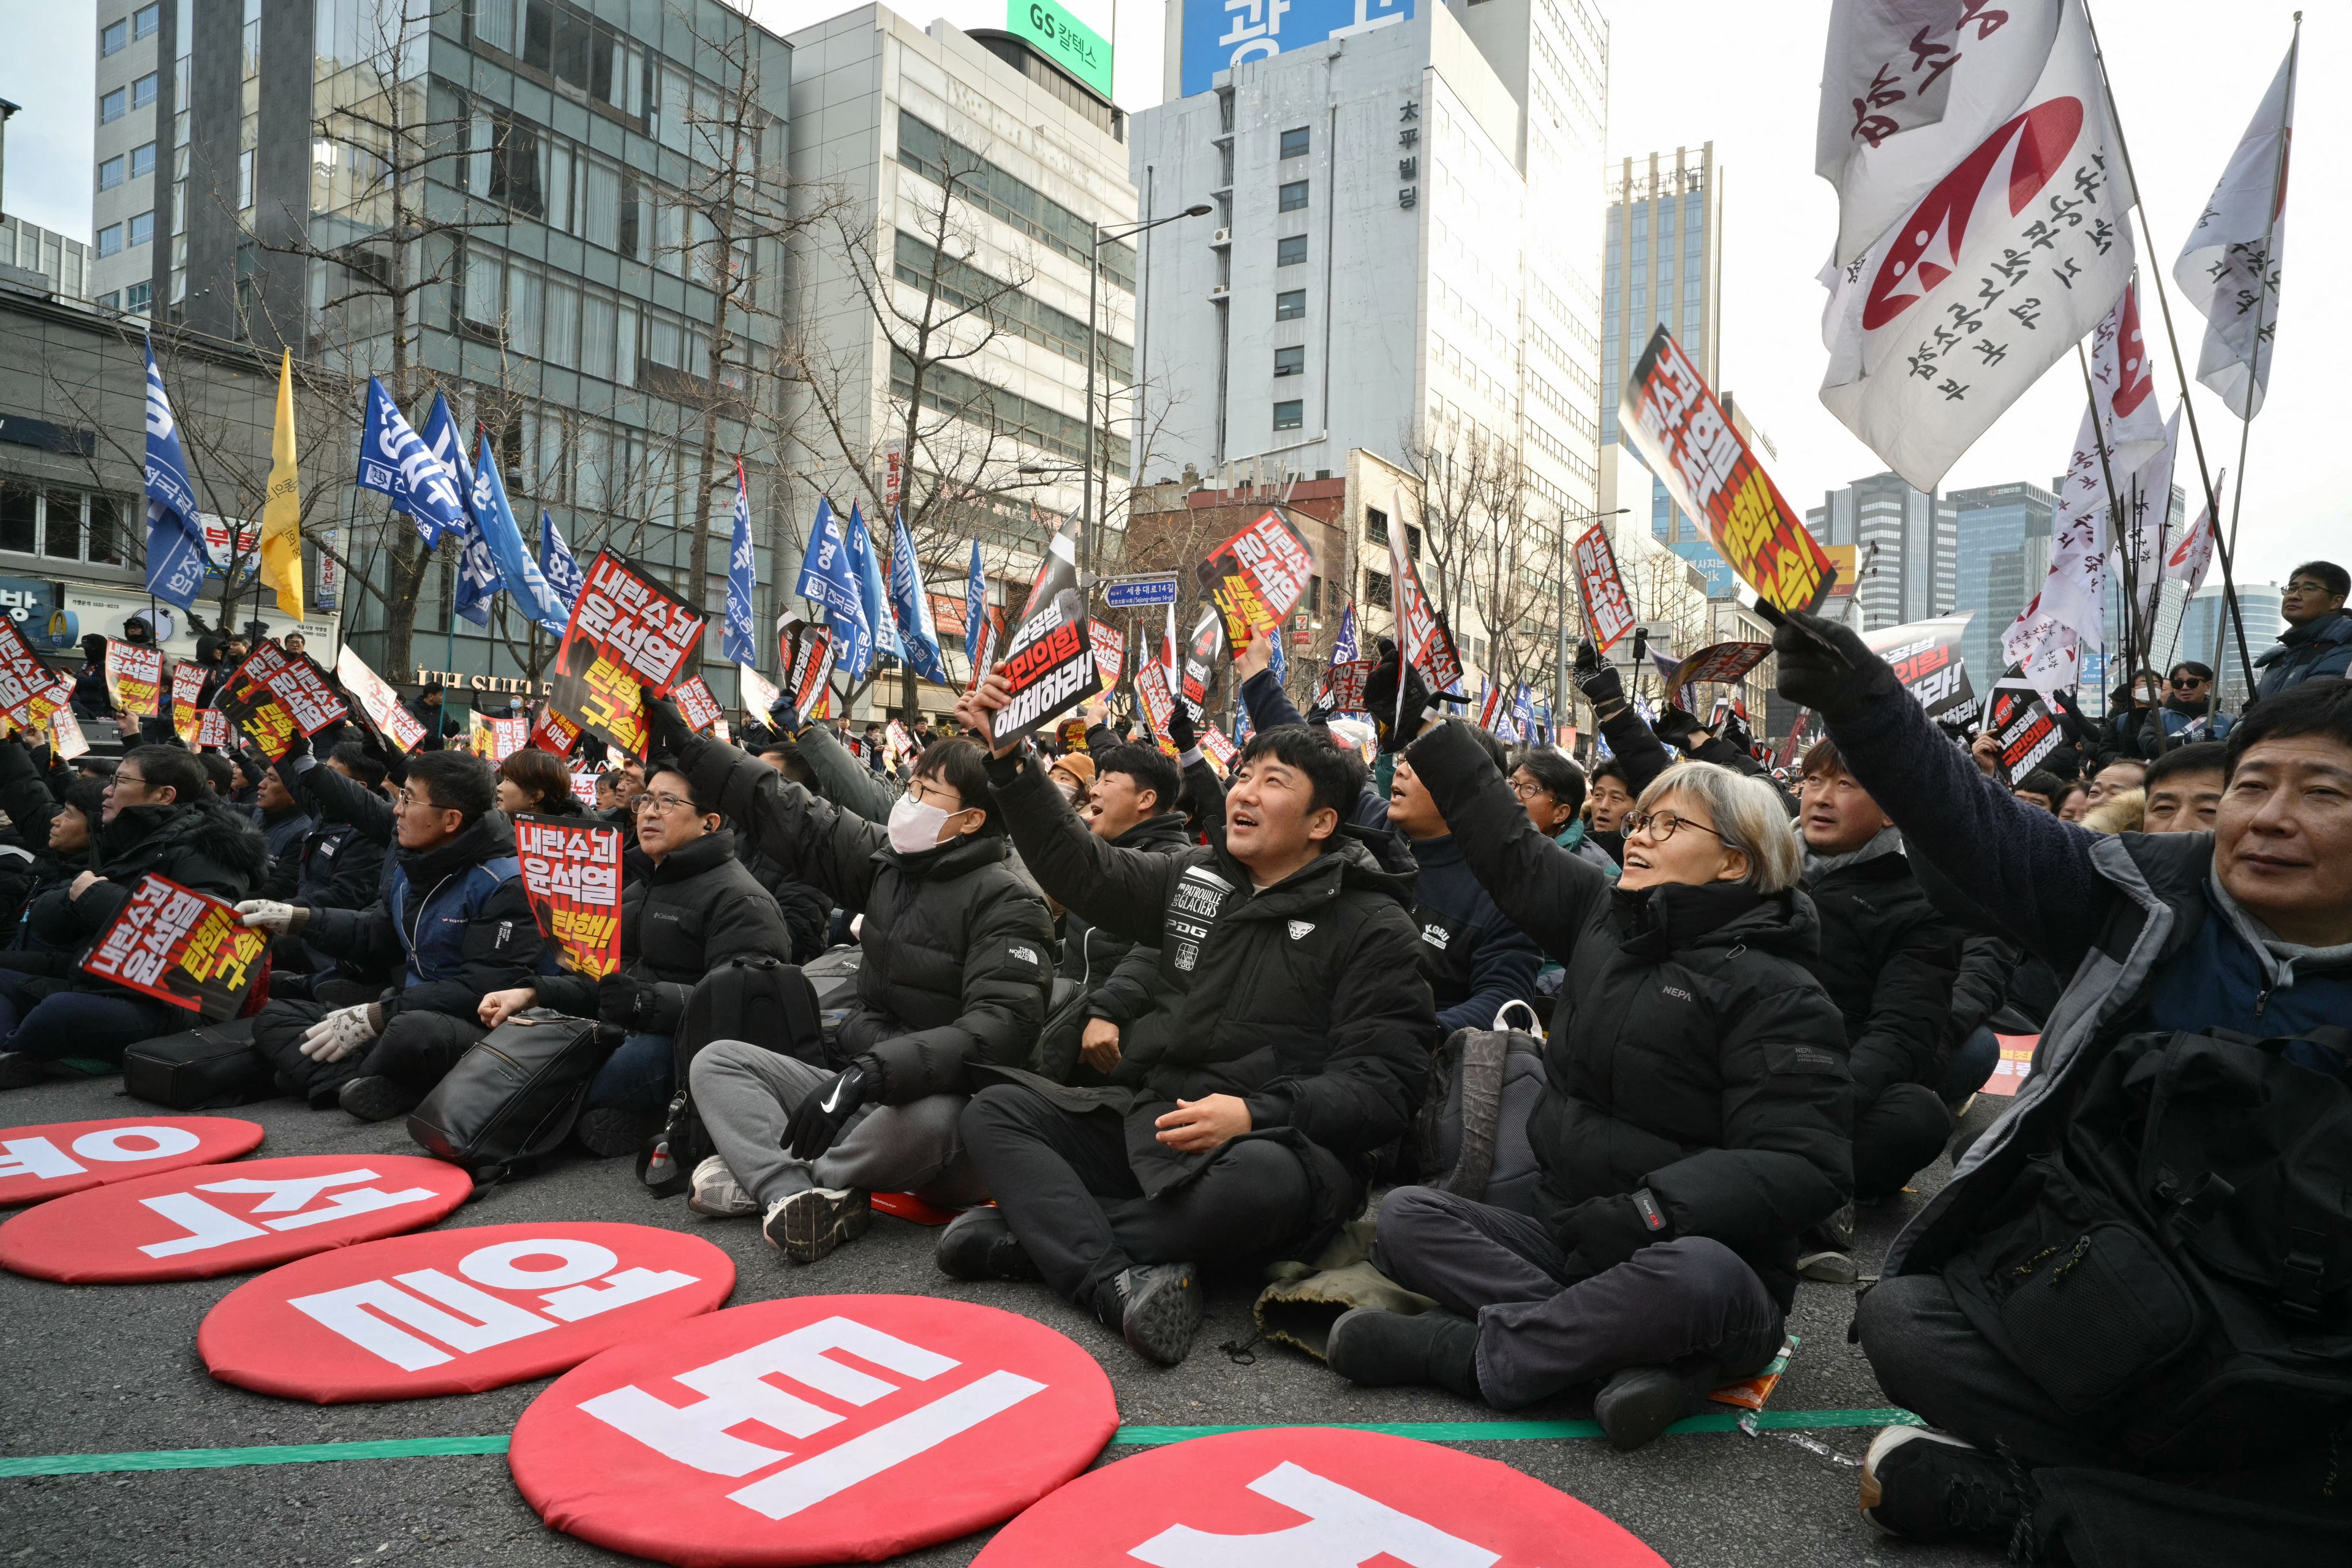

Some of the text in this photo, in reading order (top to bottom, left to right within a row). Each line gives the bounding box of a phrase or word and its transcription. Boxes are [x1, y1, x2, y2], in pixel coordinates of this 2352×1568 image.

[1030, 3, 1096, 69] GS 칼텍스
[1254, 516, 1311, 588] 내란수괴
[1126, 583, 1174, 595] 세종대로14길
[1232, 533, 1300, 615] 윤석열
[1578, 543, 1620, 642] 윤석열
[1590, 529, 1635, 628] 내란수괴
[592, 560, 703, 648] 내란수괴
[1213, 589, 1250, 648] 구속!
[1223, 575, 1276, 631] 탄핵!
[109, 641, 160, 666] 내란수괴
[577, 593, 682, 685] 윤석열
[1088, 622, 1123, 650] 내란수괴
[108, 655, 159, 683] 윤석열
[176, 665, 208, 684] 내란수괴
[584, 656, 645, 718] 탄핵!
[790, 638, 812, 695] 내란공범
[799, 643, 835, 724] 해체하라!
[1150, 660, 1175, 714] 내란수괴
[115, 680, 157, 699] 탄핵!
[174, 679, 199, 703] 윤석열
[268, 672, 328, 732] 윤석열
[288, 661, 347, 719] 내란수괴
[675, 685, 709, 728] 윤석열
[689, 677, 723, 720] 내란수괴
[995, 648, 1093, 738] 해체하라!
[1140, 669, 1166, 725] 윤석열
[199, 712, 216, 745] 윤석열
[242, 717, 287, 757] 구속!
[496, 722, 512, 759] 윤석열
[547, 725, 571, 750] 아님
[557, 714, 578, 737] 윤석열
[580, 693, 648, 754] 구속!
[1210, 727, 1237, 755] 내란수괴
[1997, 707, 2039, 750] 내란공범
[2002, 715, 2054, 767] 국민의힘
[1204, 735, 1231, 763] 윤석열
[2011, 723, 2063, 785] 해체하라!
[520, 826, 617, 864] 내란수괴
[524, 858, 616, 906] 윤석열
[1171, 894, 1180, 907] DES
[1183, 884, 1223, 905] PATROUILLE
[92, 875, 173, 974] 내란수괴
[658, 913, 678, 921] Columbia
[1178, 895, 1218, 918] GLACIERS
[123, 891, 206, 986] 윤석열
[180, 906, 234, 983] 탄핵!
[552, 909, 618, 948] 탄핵!
[1166, 919, 1207, 938] PDG
[1422, 934, 1435, 943] SINCE
[1425, 924, 1450, 941] KGEU
[214, 925, 268, 992] 구속!
[1009, 949, 1029, 958] NORTH
[1663, 985, 1691, 1002] NEPA
[1643, 1200, 1653, 1214] Safety
